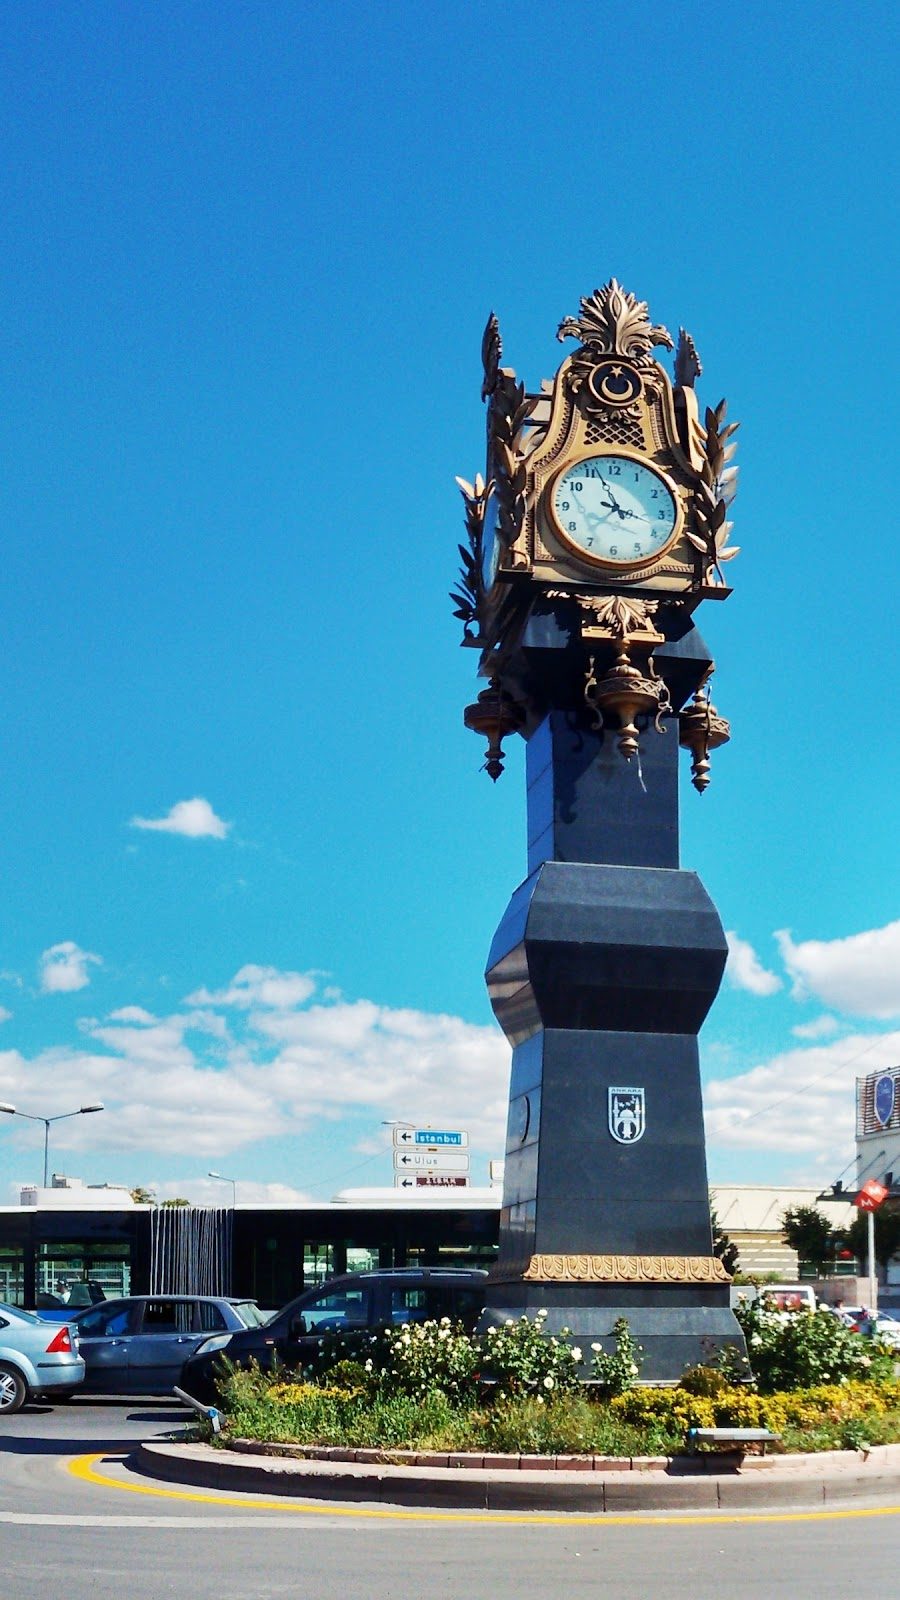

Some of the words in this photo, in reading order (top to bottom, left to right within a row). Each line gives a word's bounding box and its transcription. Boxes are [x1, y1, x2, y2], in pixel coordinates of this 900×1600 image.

[585, 468, 596, 478] 11
[608, 465, 621, 475] 12
[634, 473, 639, 482] 1
[569, 481, 583, 492] 10
[650, 489, 658, 499] 2
[562, 501, 570, 511] 9
[658, 510, 665, 520] 3
[569, 522, 577, 531] 8
[586, 537, 594, 547] 7
[609, 546, 618, 555] 6
[634, 543, 641, 552] 5
[414, 1156, 438, 1165] Ulus
[860, 1198, 874, 1207] M
